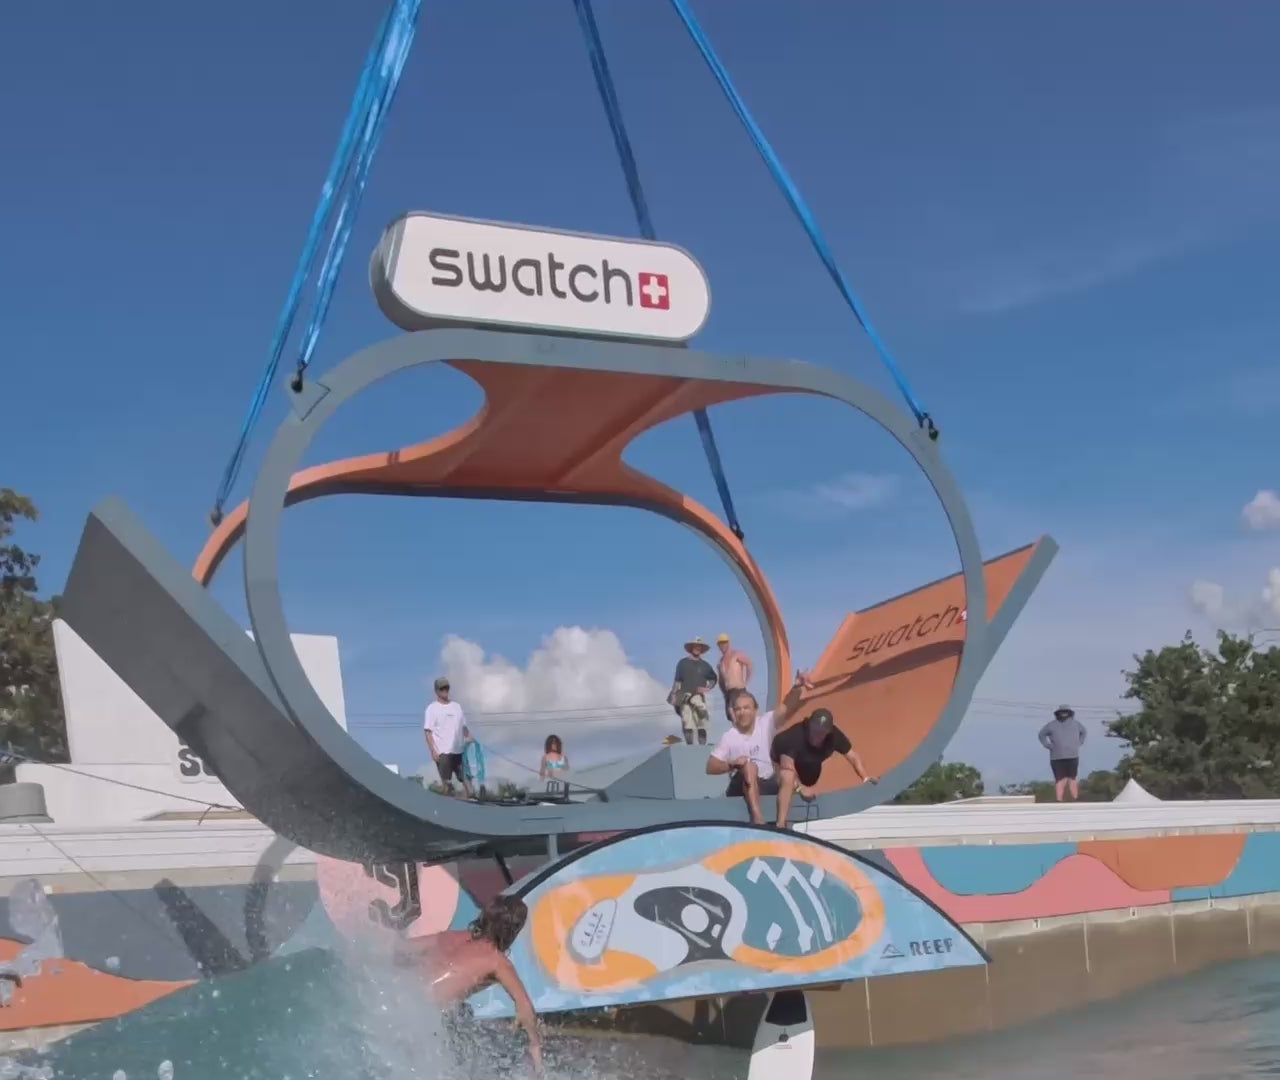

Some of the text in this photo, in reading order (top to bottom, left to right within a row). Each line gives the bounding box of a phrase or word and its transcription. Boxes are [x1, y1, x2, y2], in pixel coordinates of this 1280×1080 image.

[428, 247, 634, 307] swatch
[846, 604, 960, 661] swatch
[909, 937, 953, 957] REEF
